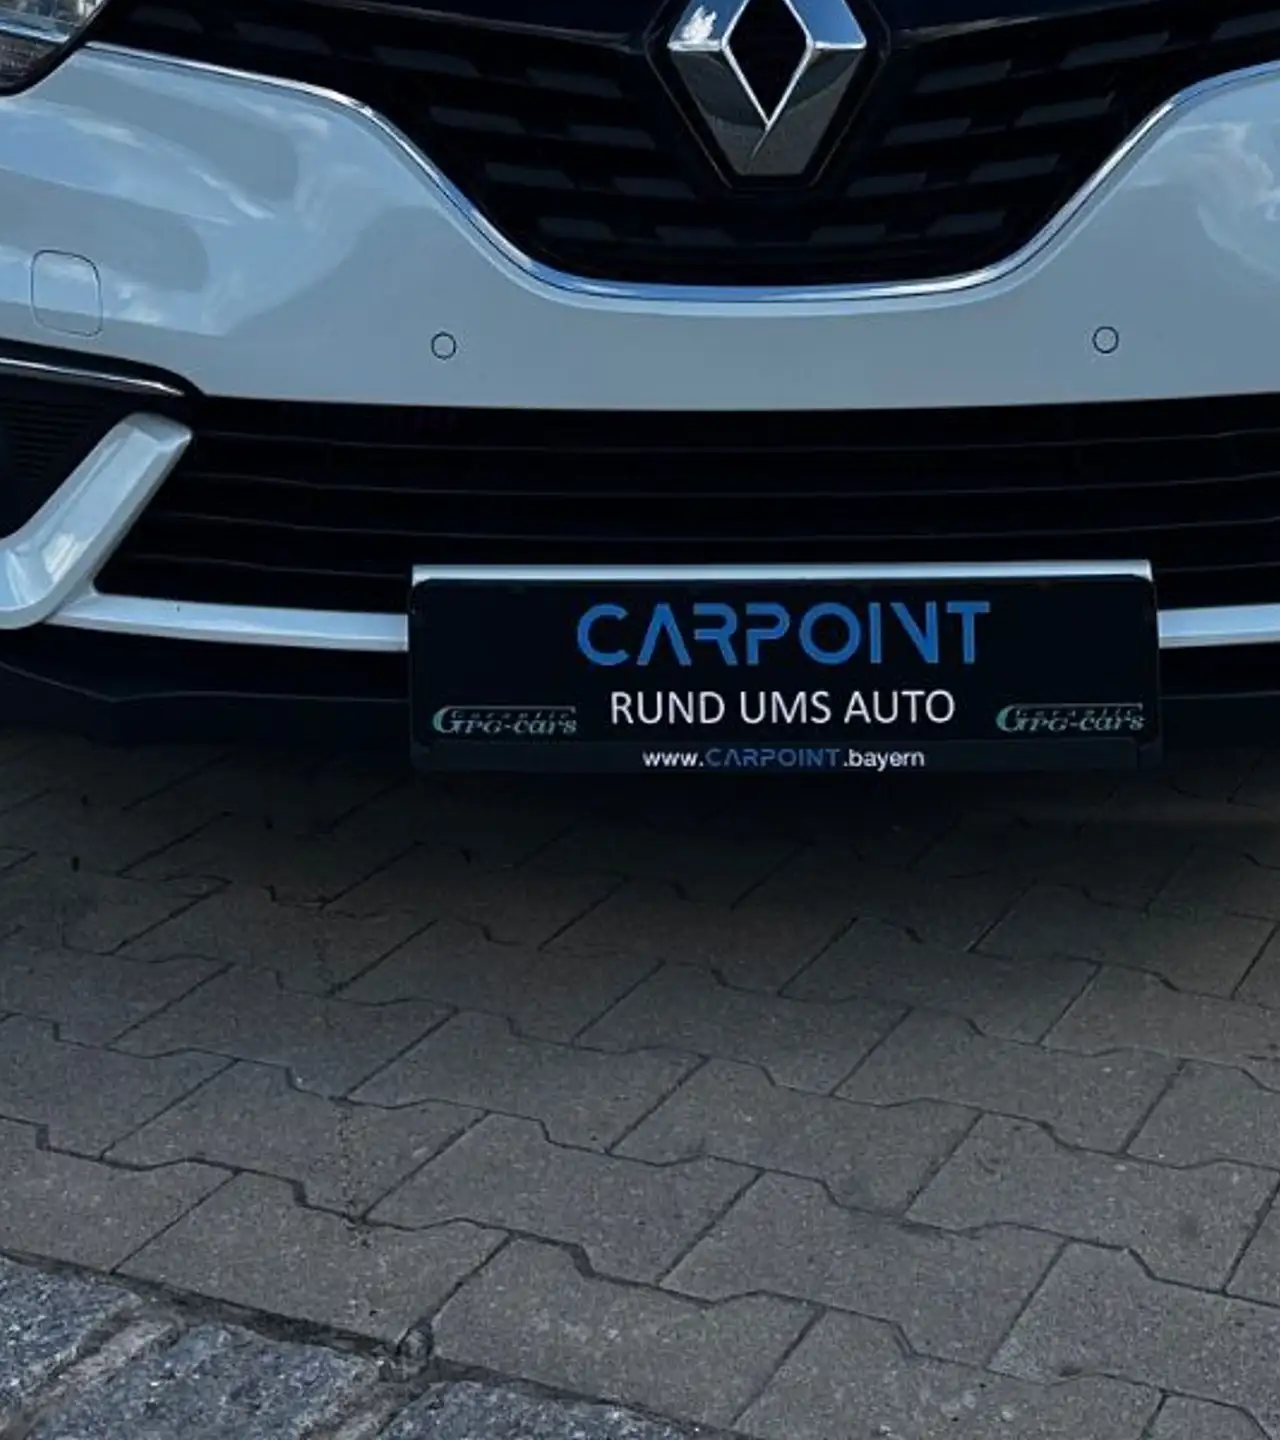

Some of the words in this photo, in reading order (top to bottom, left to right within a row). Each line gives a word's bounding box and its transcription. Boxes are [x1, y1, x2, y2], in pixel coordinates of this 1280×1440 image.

[577, 601, 991, 666] CARPOINT
[611, 690, 726, 725] RUND
[740, 690, 832, 725] UMS
[844, 689, 955, 724] AUTO
